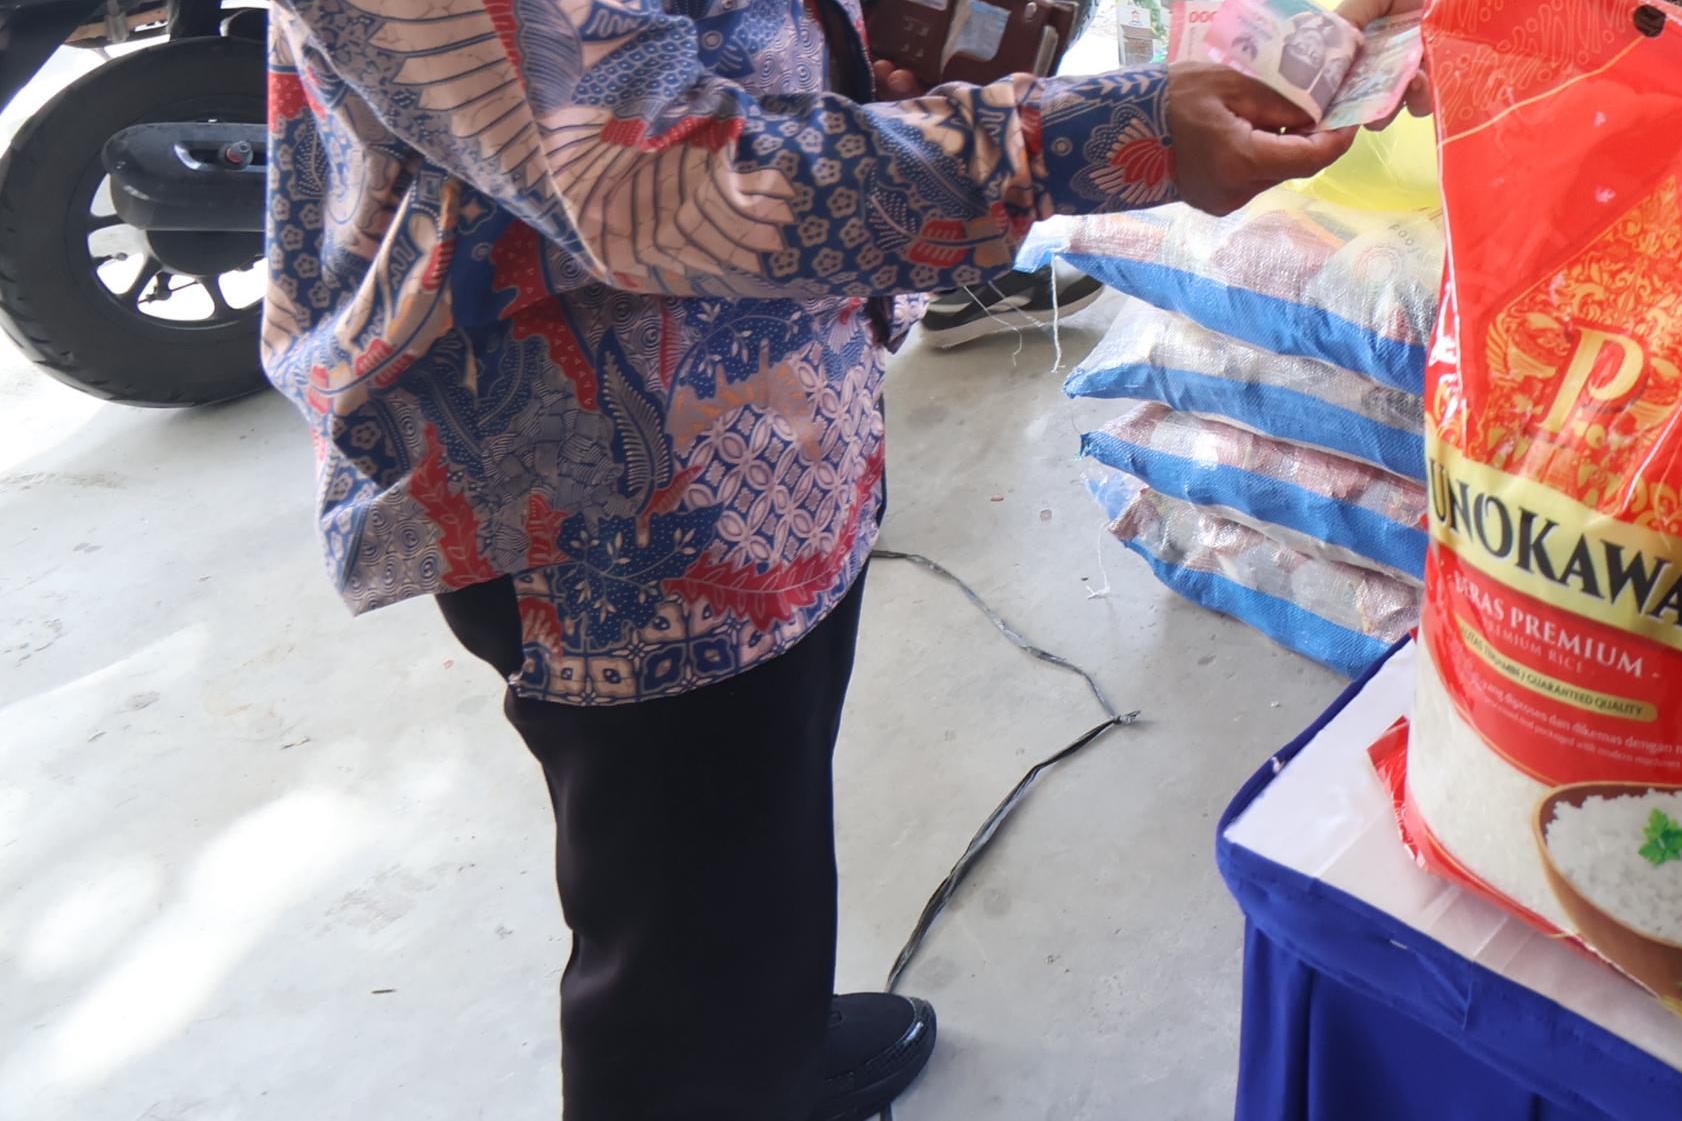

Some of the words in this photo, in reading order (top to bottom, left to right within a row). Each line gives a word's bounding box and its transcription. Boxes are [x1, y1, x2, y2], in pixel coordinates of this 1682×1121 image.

[1510, 606, 1644, 679] PREMIUM
[1548, 650, 1584, 674] RICE
[1526, 671, 1594, 707] GUARANTEED
[1594, 695, 1646, 716] QUALITY
[1624, 735, 1673, 755] dengan
